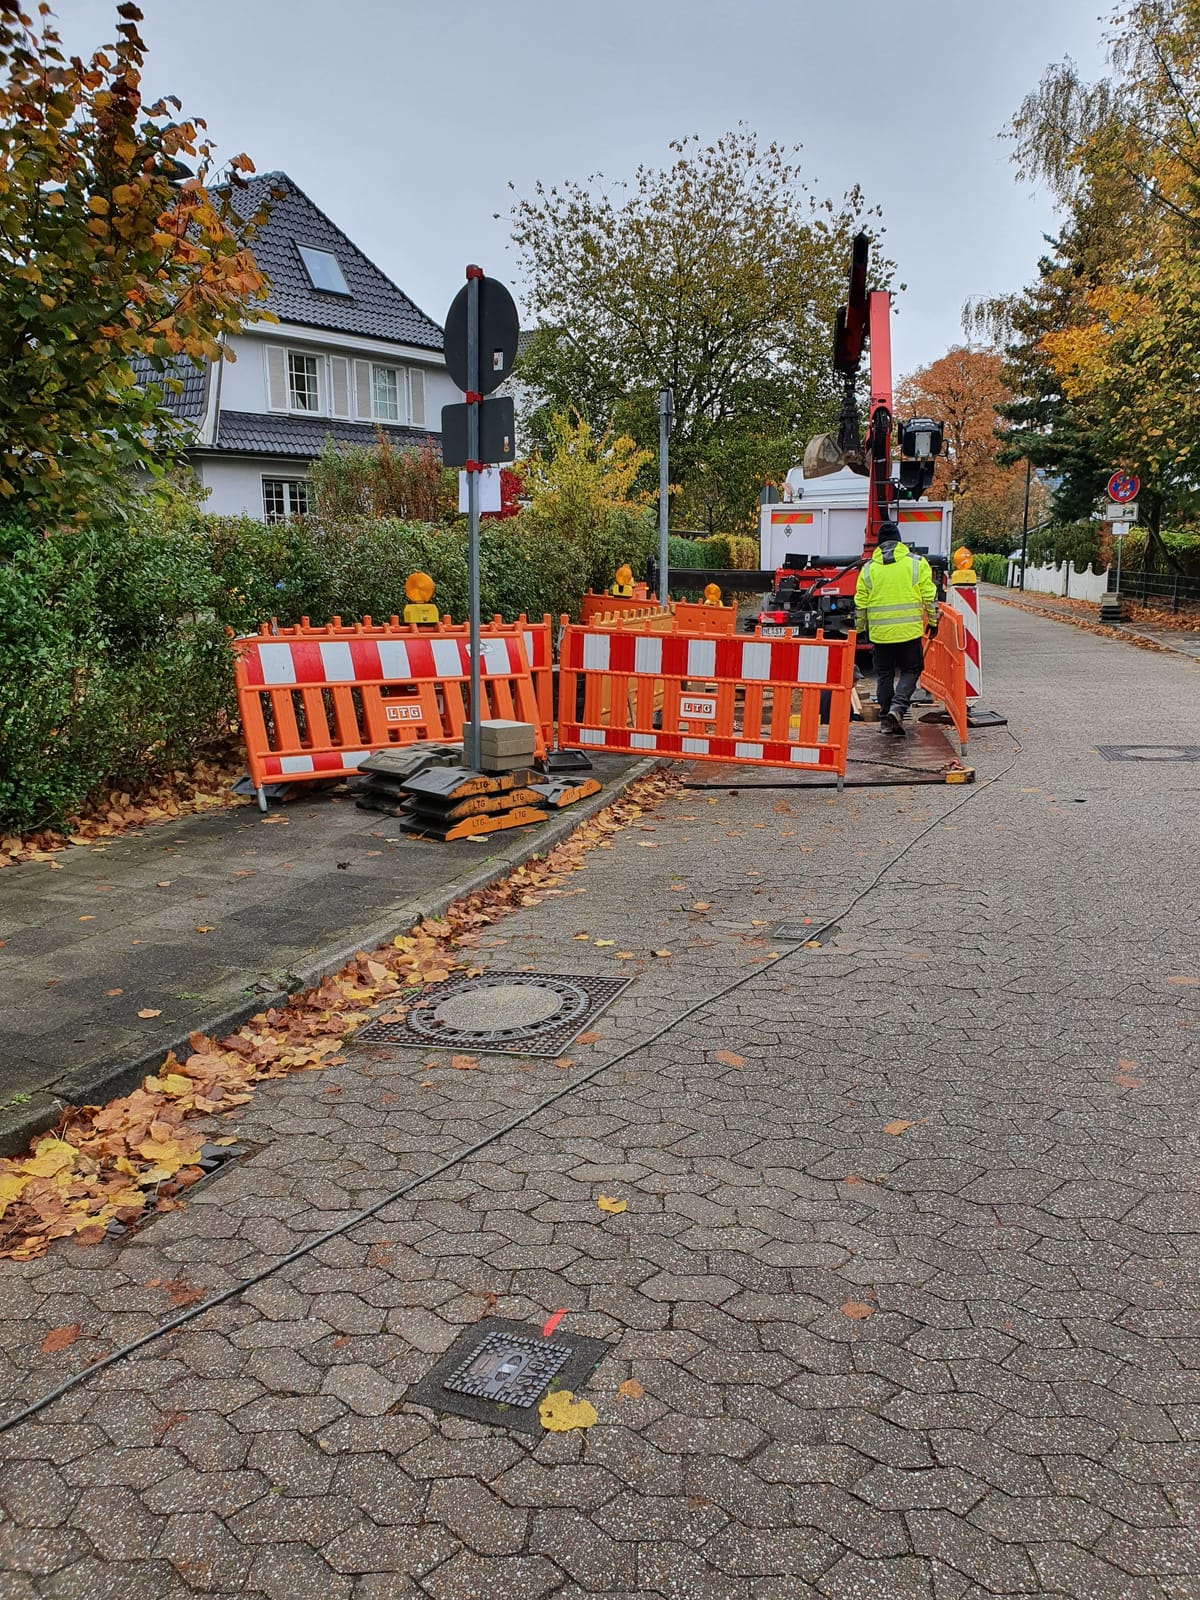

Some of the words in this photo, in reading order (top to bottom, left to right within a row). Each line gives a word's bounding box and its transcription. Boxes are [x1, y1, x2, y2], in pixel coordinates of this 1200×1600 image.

[389, 707, 419, 718] LTG
[684, 703, 711, 713] LTG
[475, 782, 489, 790] LTG
[512, 793, 525, 802] LTG
[473, 800, 486, 809] LTG
[514, 810, 527, 819] LTG
[516, 1361, 545, 1386] GAS
